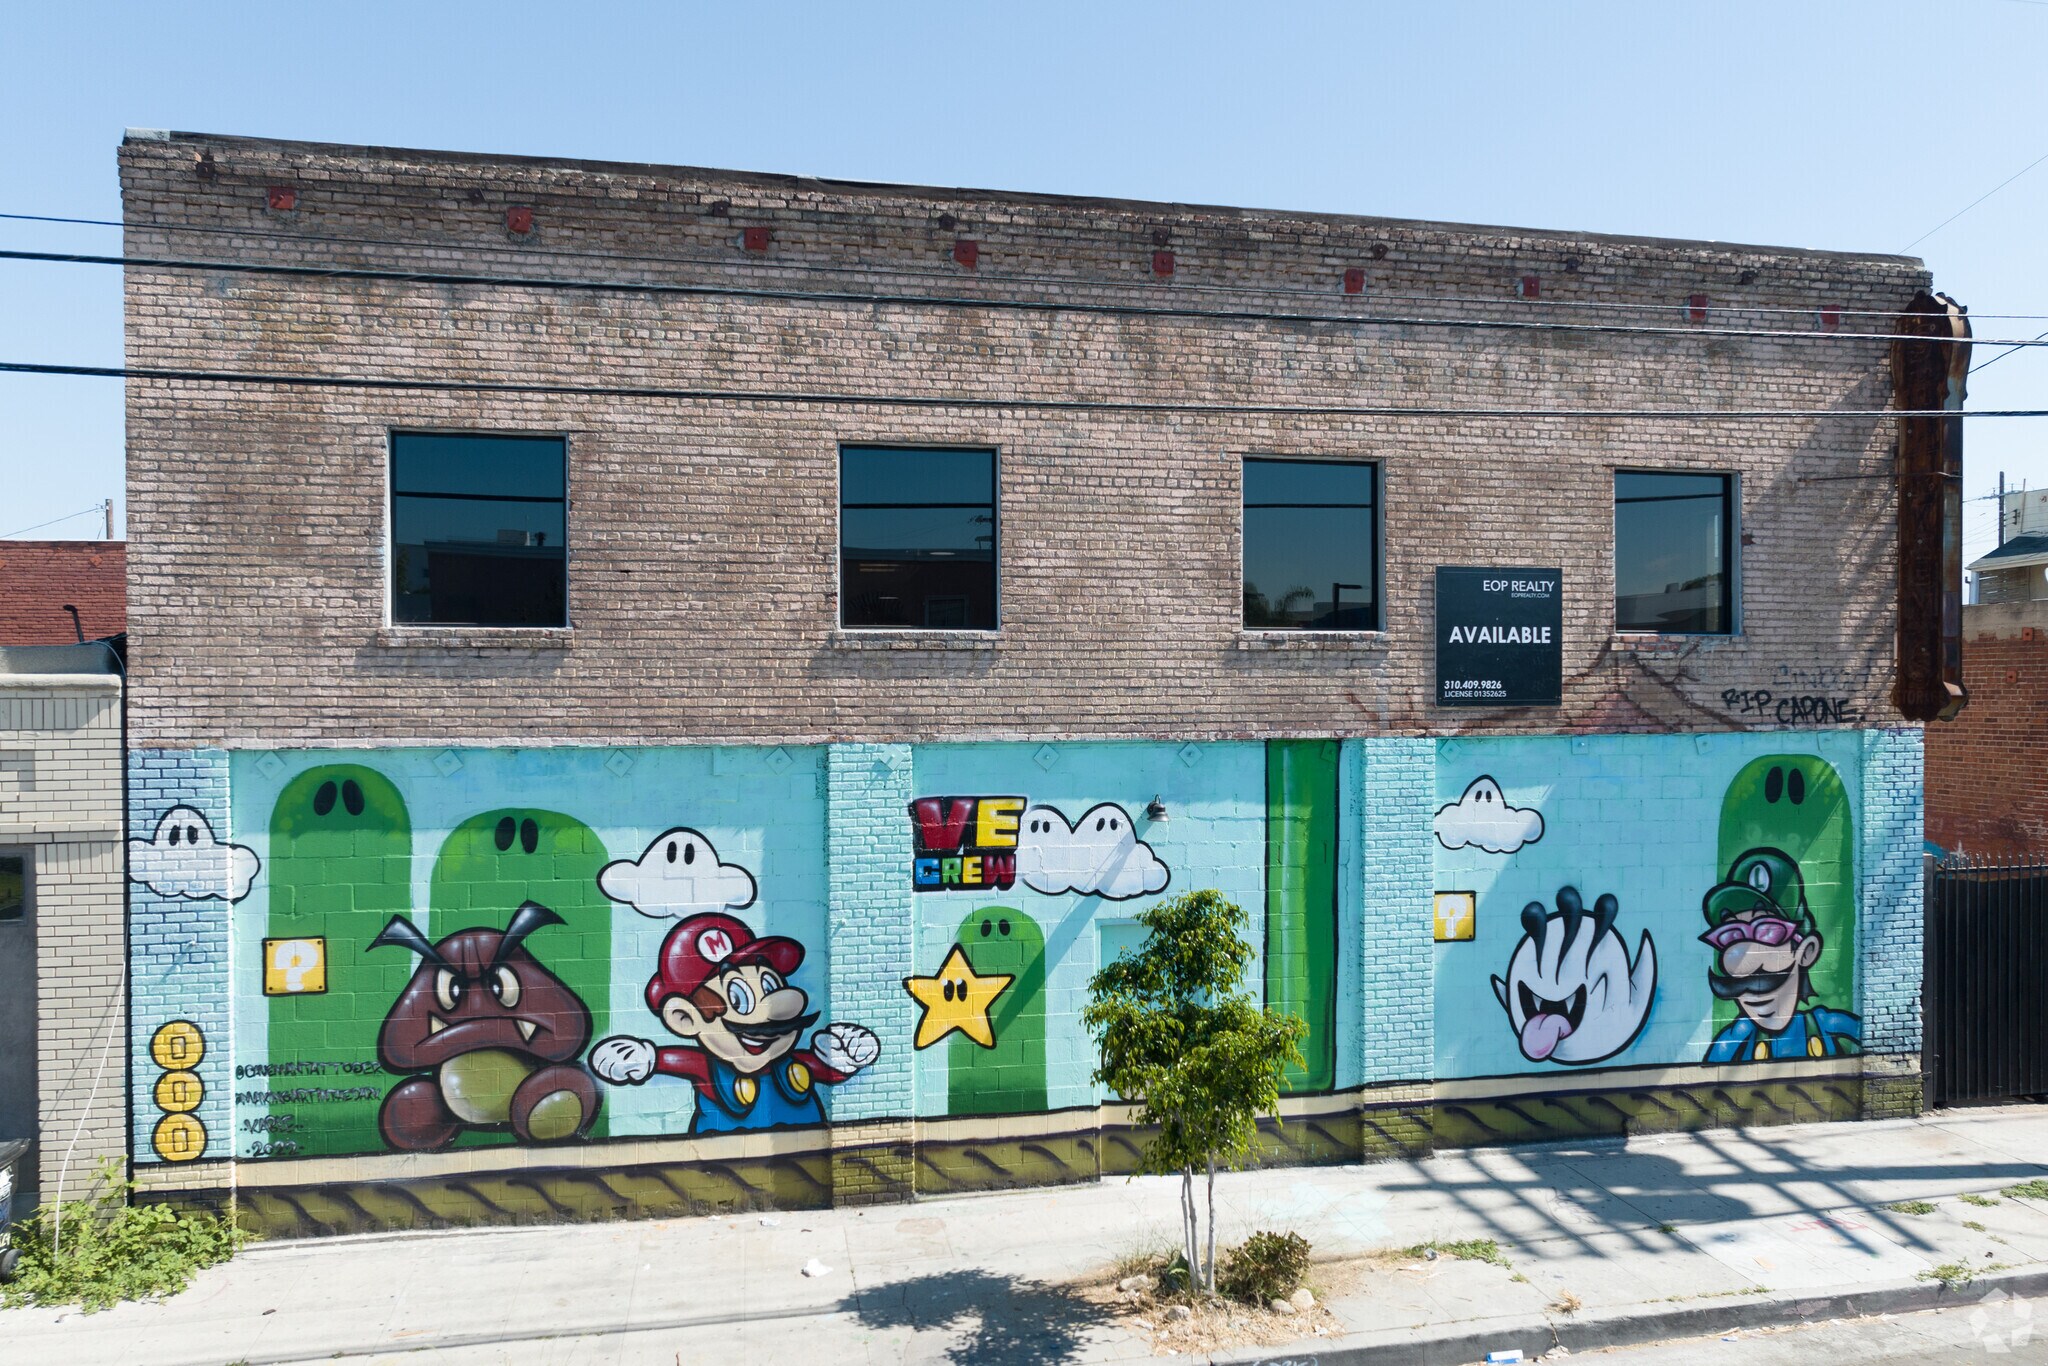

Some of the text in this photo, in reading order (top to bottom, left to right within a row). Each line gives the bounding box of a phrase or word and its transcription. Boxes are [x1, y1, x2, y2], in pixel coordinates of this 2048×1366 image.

[1483, 580, 1555, 592] EOP REALTY
[1449, 626, 1551, 643] AVAILABLE
[1444, 680, 1502, 689] 310.409.9826
[1444, 690, 1507, 698] LICENSE 01352625
[913, 854, 1016, 891] CREW
[704, 930, 727, 957] M
